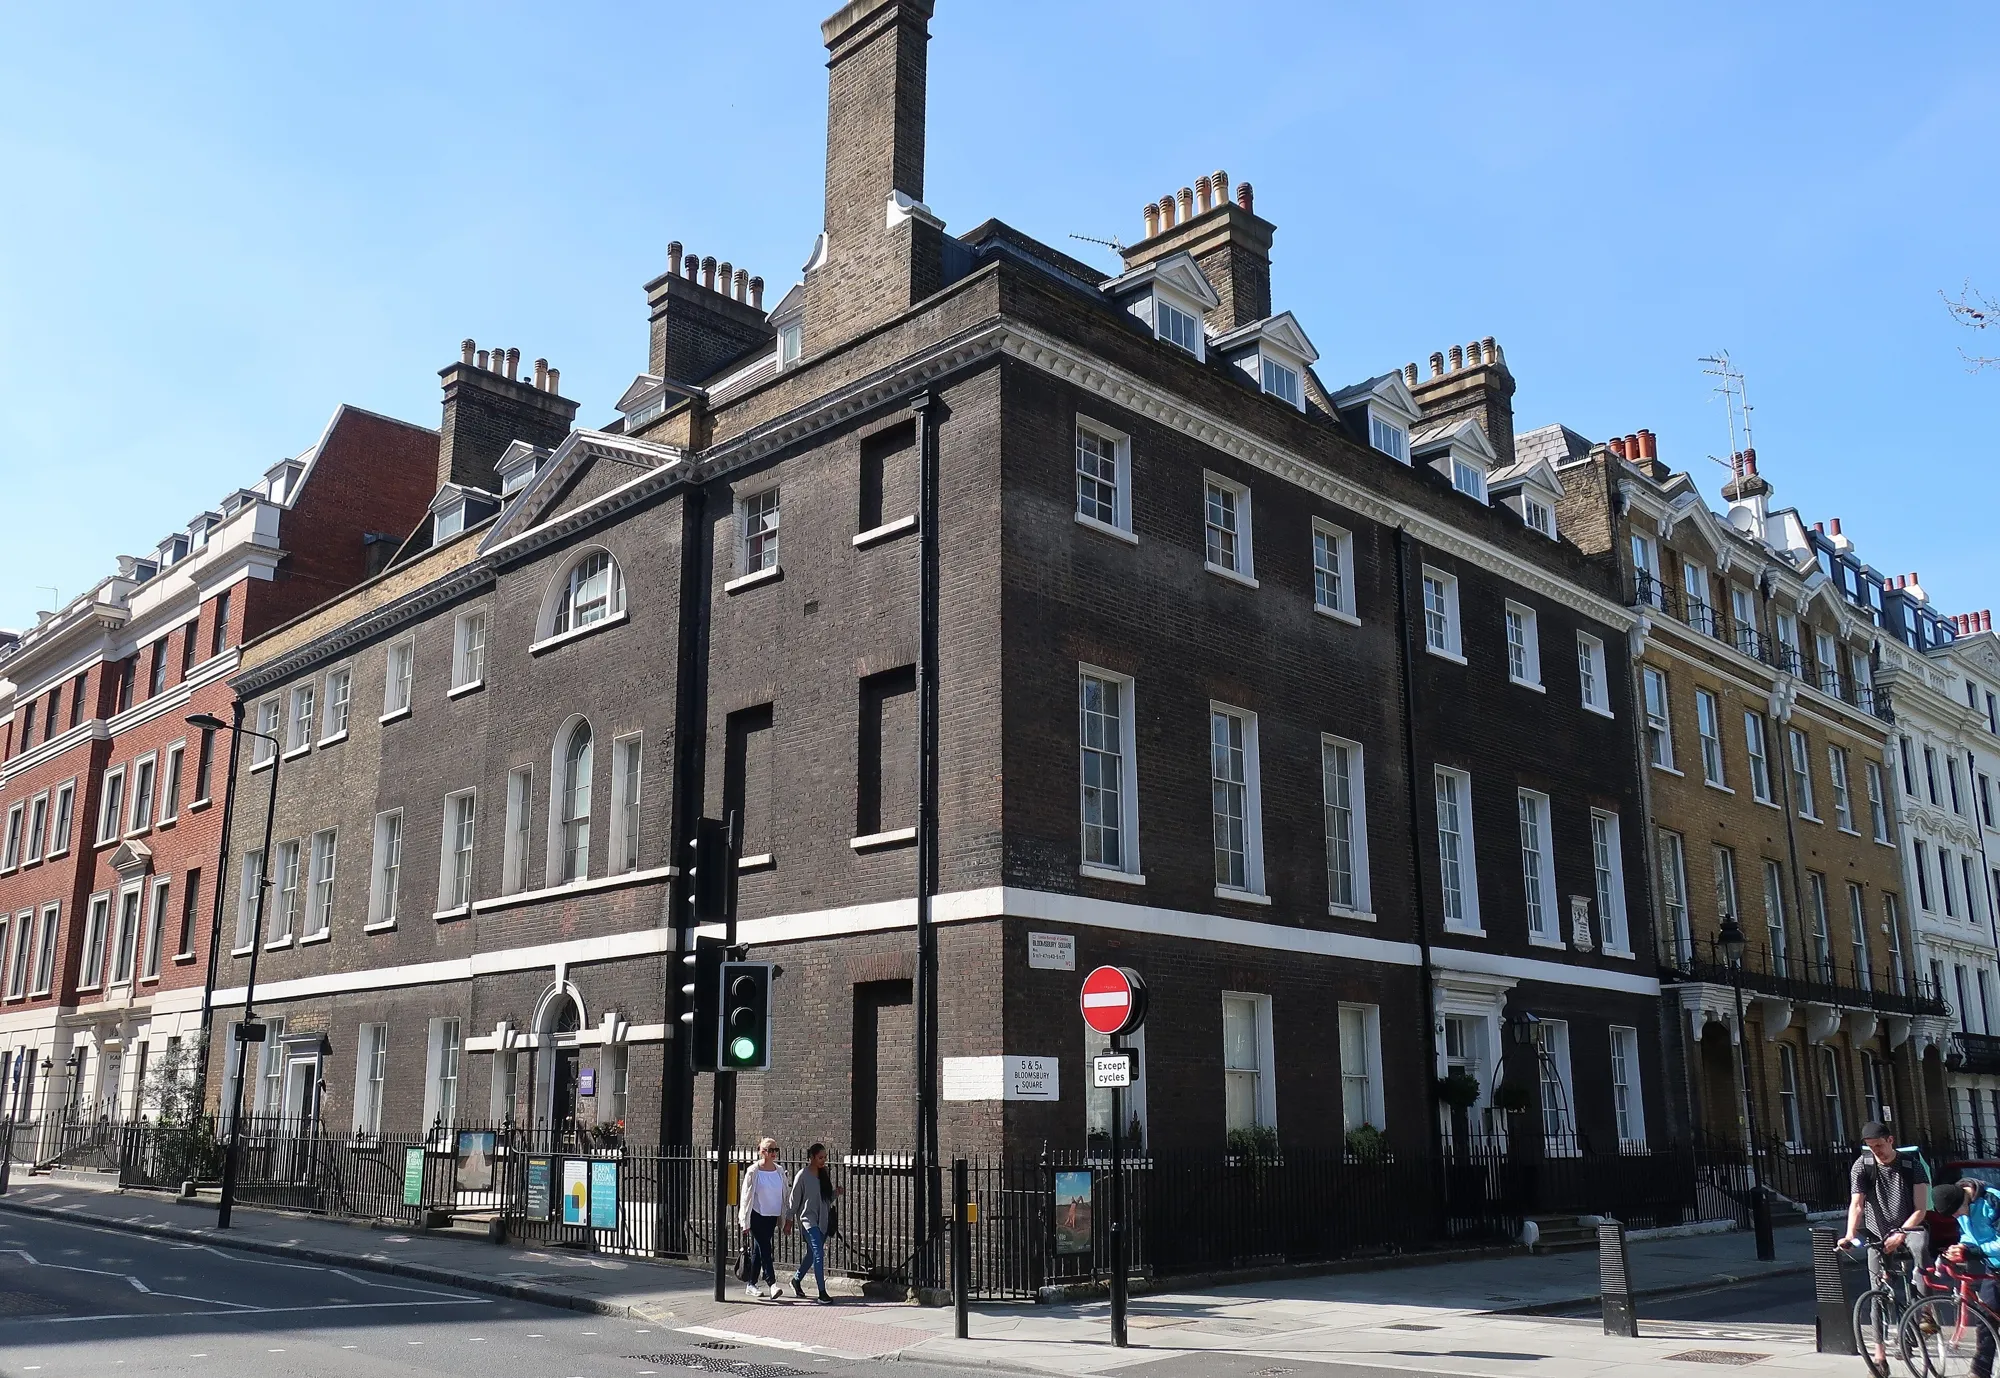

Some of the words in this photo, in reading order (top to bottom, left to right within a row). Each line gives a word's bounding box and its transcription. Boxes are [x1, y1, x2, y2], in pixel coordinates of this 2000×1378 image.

[1032, 940, 1057, 948] BLOOMSBURY
[1021, 1061, 1026, 1070] 5
[1028, 1061, 1033, 1070] &
[1097, 1061, 1126, 1071] Except
[1014, 1071, 1050, 1080] BLOOMSBURY
[1098, 1073, 1125, 1083] cycles
[1021, 1081, 1043, 1089] SQUARE
